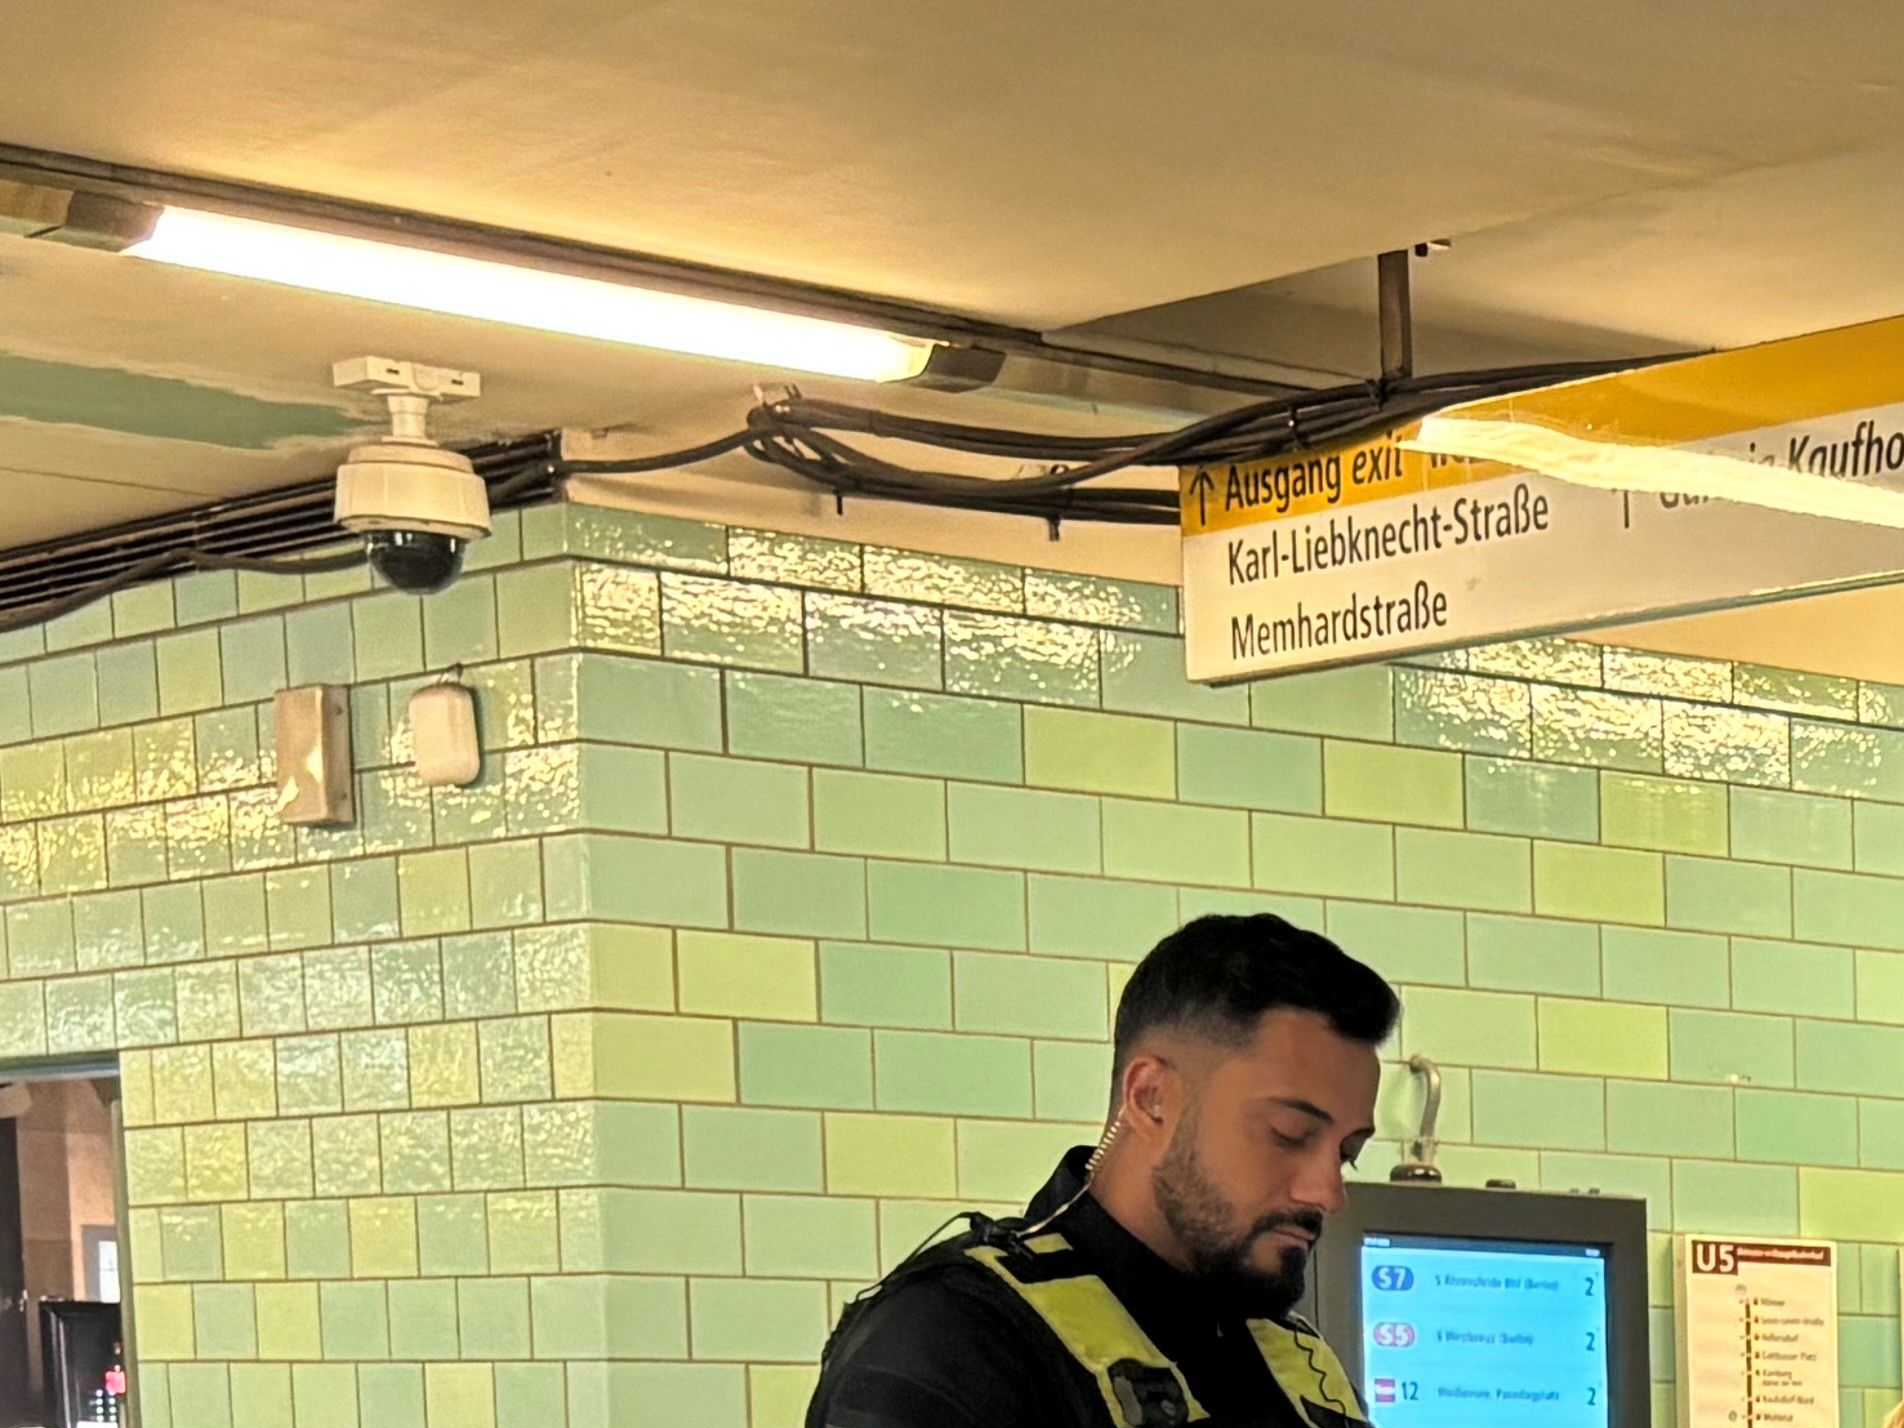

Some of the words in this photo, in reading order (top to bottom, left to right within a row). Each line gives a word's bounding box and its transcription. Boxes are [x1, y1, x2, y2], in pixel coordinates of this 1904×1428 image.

[1225, 453, 1342, 513] Ausgang
[1352, 433, 1403, 485] exit
[1229, 483, 1550, 586] Karl-Liebknecht-Straße
[1232, 581, 1448, 660] Memhardstraße
[1696, 1243, 1735, 1272] U5
[1378, 1267, 1407, 1288] S7
[1584, 1276, 1594, 1297] 2
[1380, 1324, 1410, 1346] S5
[1584, 1331, 1595, 1351] 2
[1401, 1381, 1419, 1401] 12
[1586, 1387, 1596, 1406] 2
